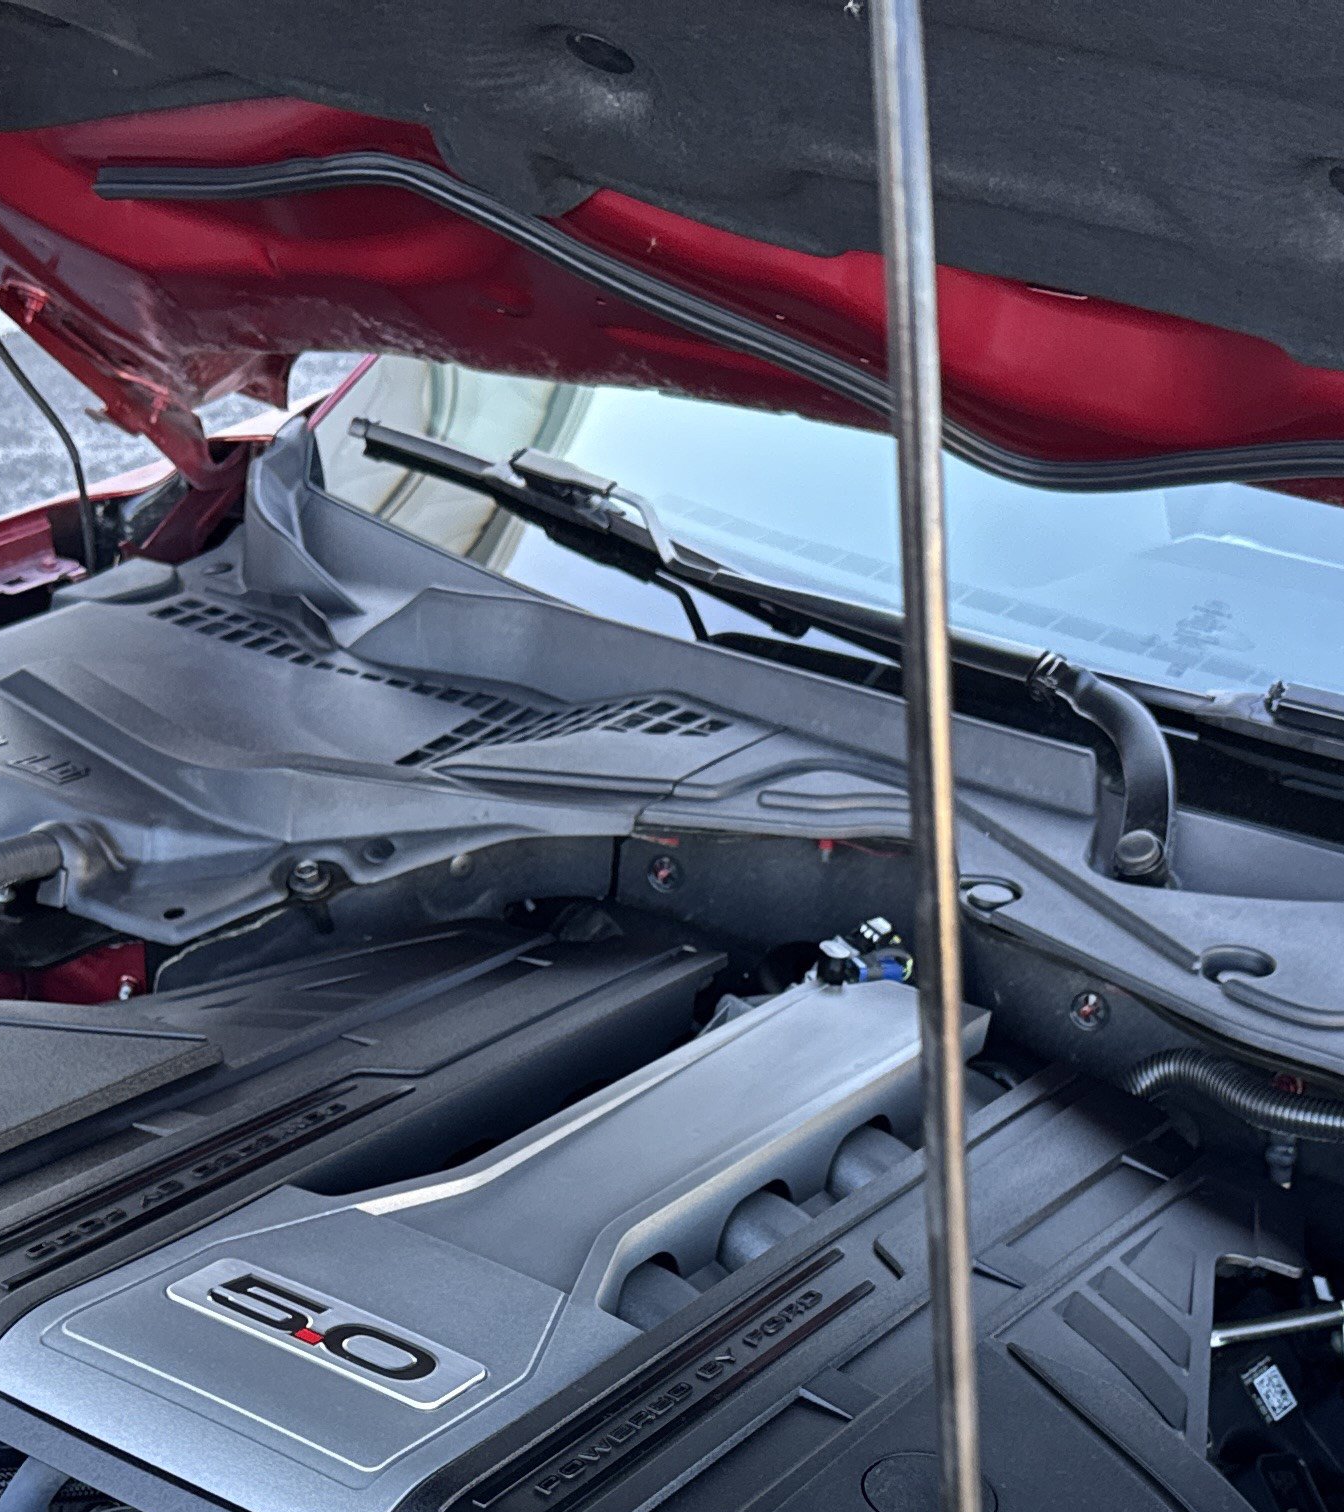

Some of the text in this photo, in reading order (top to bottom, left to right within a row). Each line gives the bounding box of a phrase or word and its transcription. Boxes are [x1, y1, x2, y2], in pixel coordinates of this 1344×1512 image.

[209, 1273, 438, 1381] 5.0
[534, 1288, 824, 1496] POWERED BY FORD
